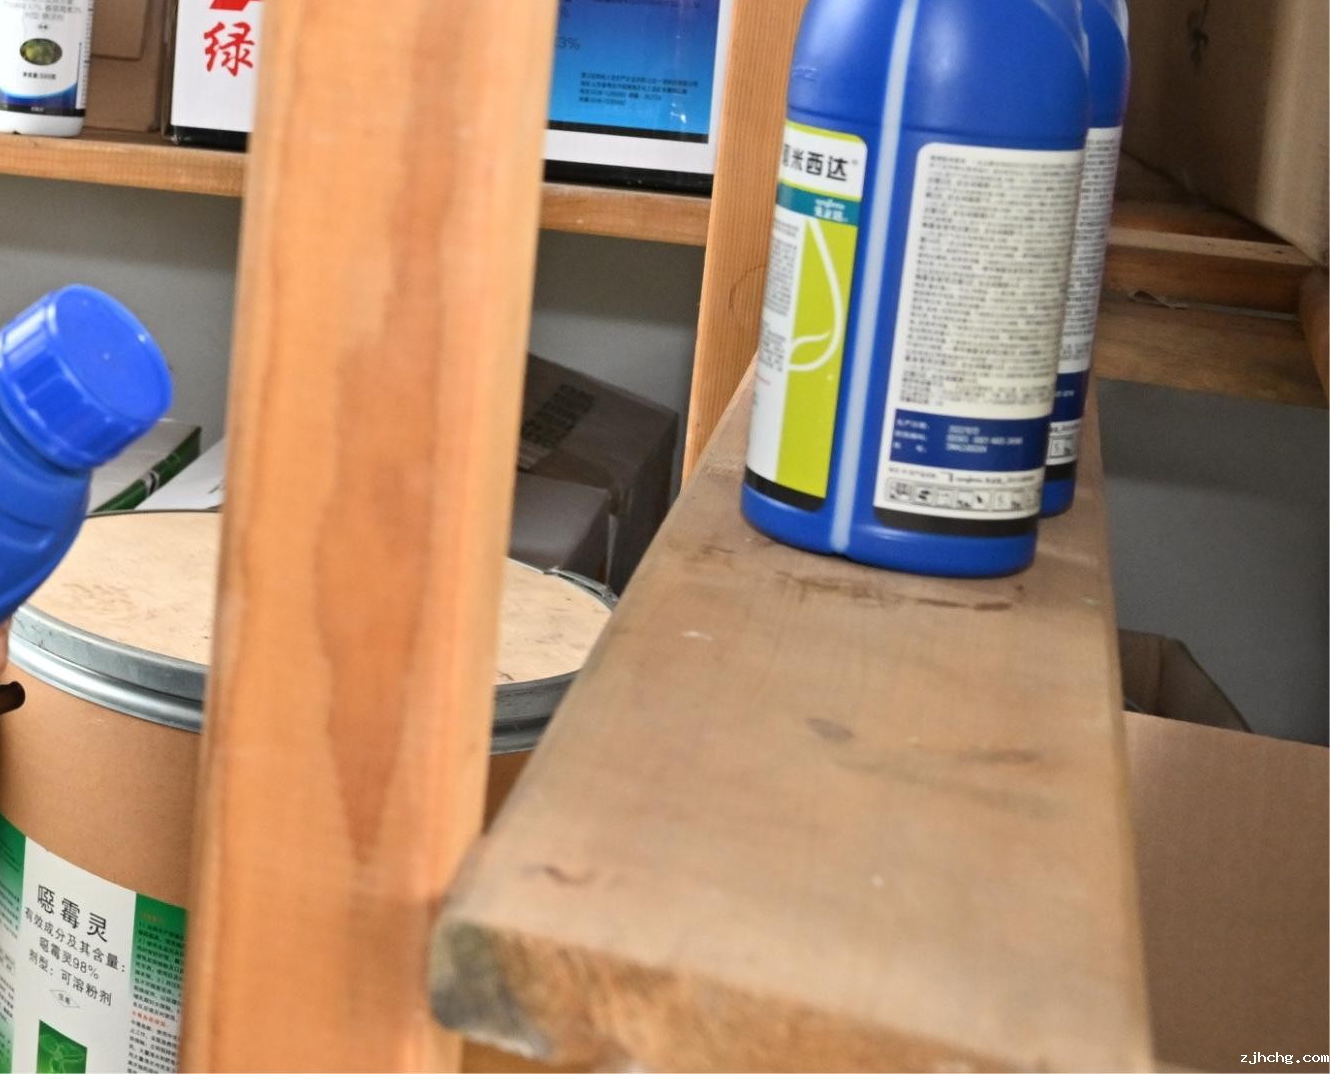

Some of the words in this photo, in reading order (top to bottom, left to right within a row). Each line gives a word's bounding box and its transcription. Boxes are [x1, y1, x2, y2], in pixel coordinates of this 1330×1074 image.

[204, 22, 255, 77] 绿
[24, 906, 126, 973] 有效成分及其含量:
